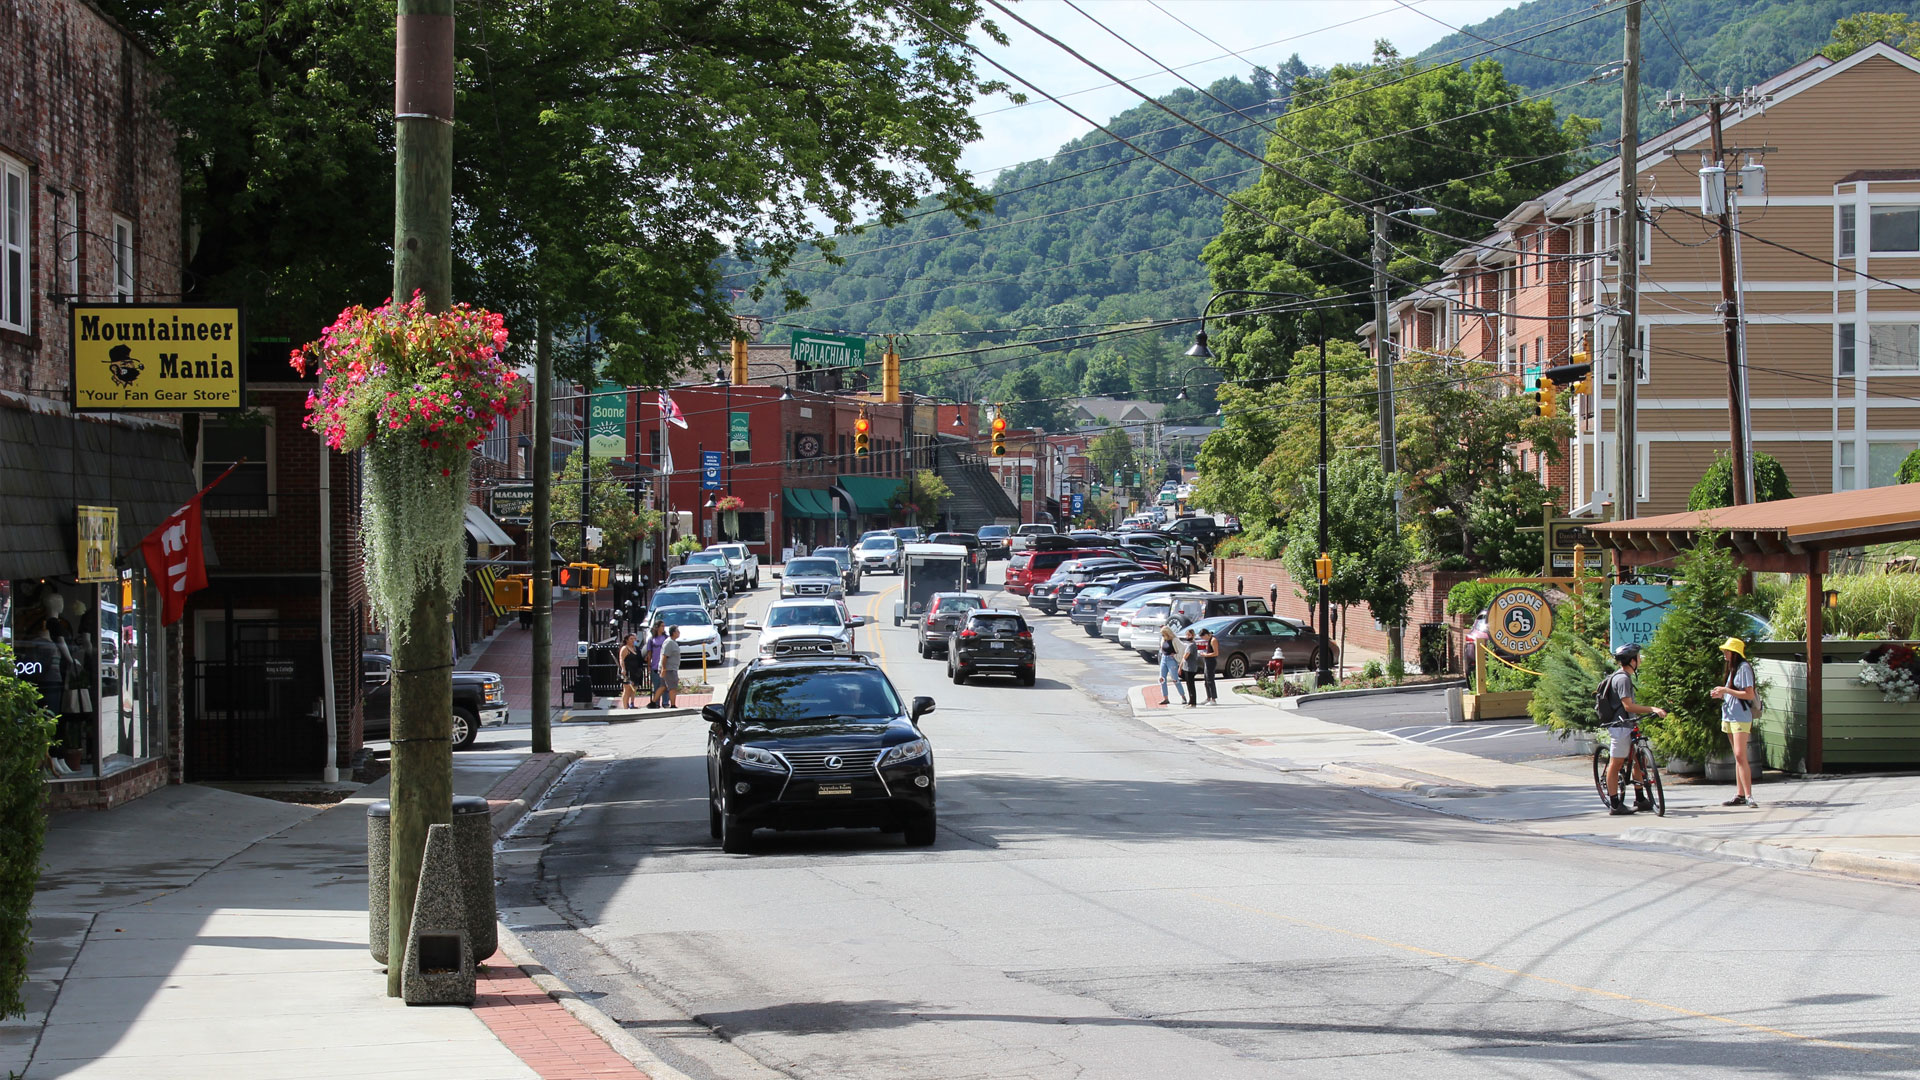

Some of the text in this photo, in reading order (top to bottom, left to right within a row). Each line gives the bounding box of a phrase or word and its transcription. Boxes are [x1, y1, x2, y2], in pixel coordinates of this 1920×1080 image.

[80, 315, 233, 341] Mountaineer
[792, 341, 860, 367] APPALACHIAN ST
[159, 353, 234, 379] Mania
[851, 357, 863, 367] 100
[124, 390, 149, 401] Fan
[154, 390, 188, 401] Gear
[592, 405, 625, 418] Boone
[1498, 593, 1543, 611] BOONE
[1618, 622, 1652, 633] WILD
